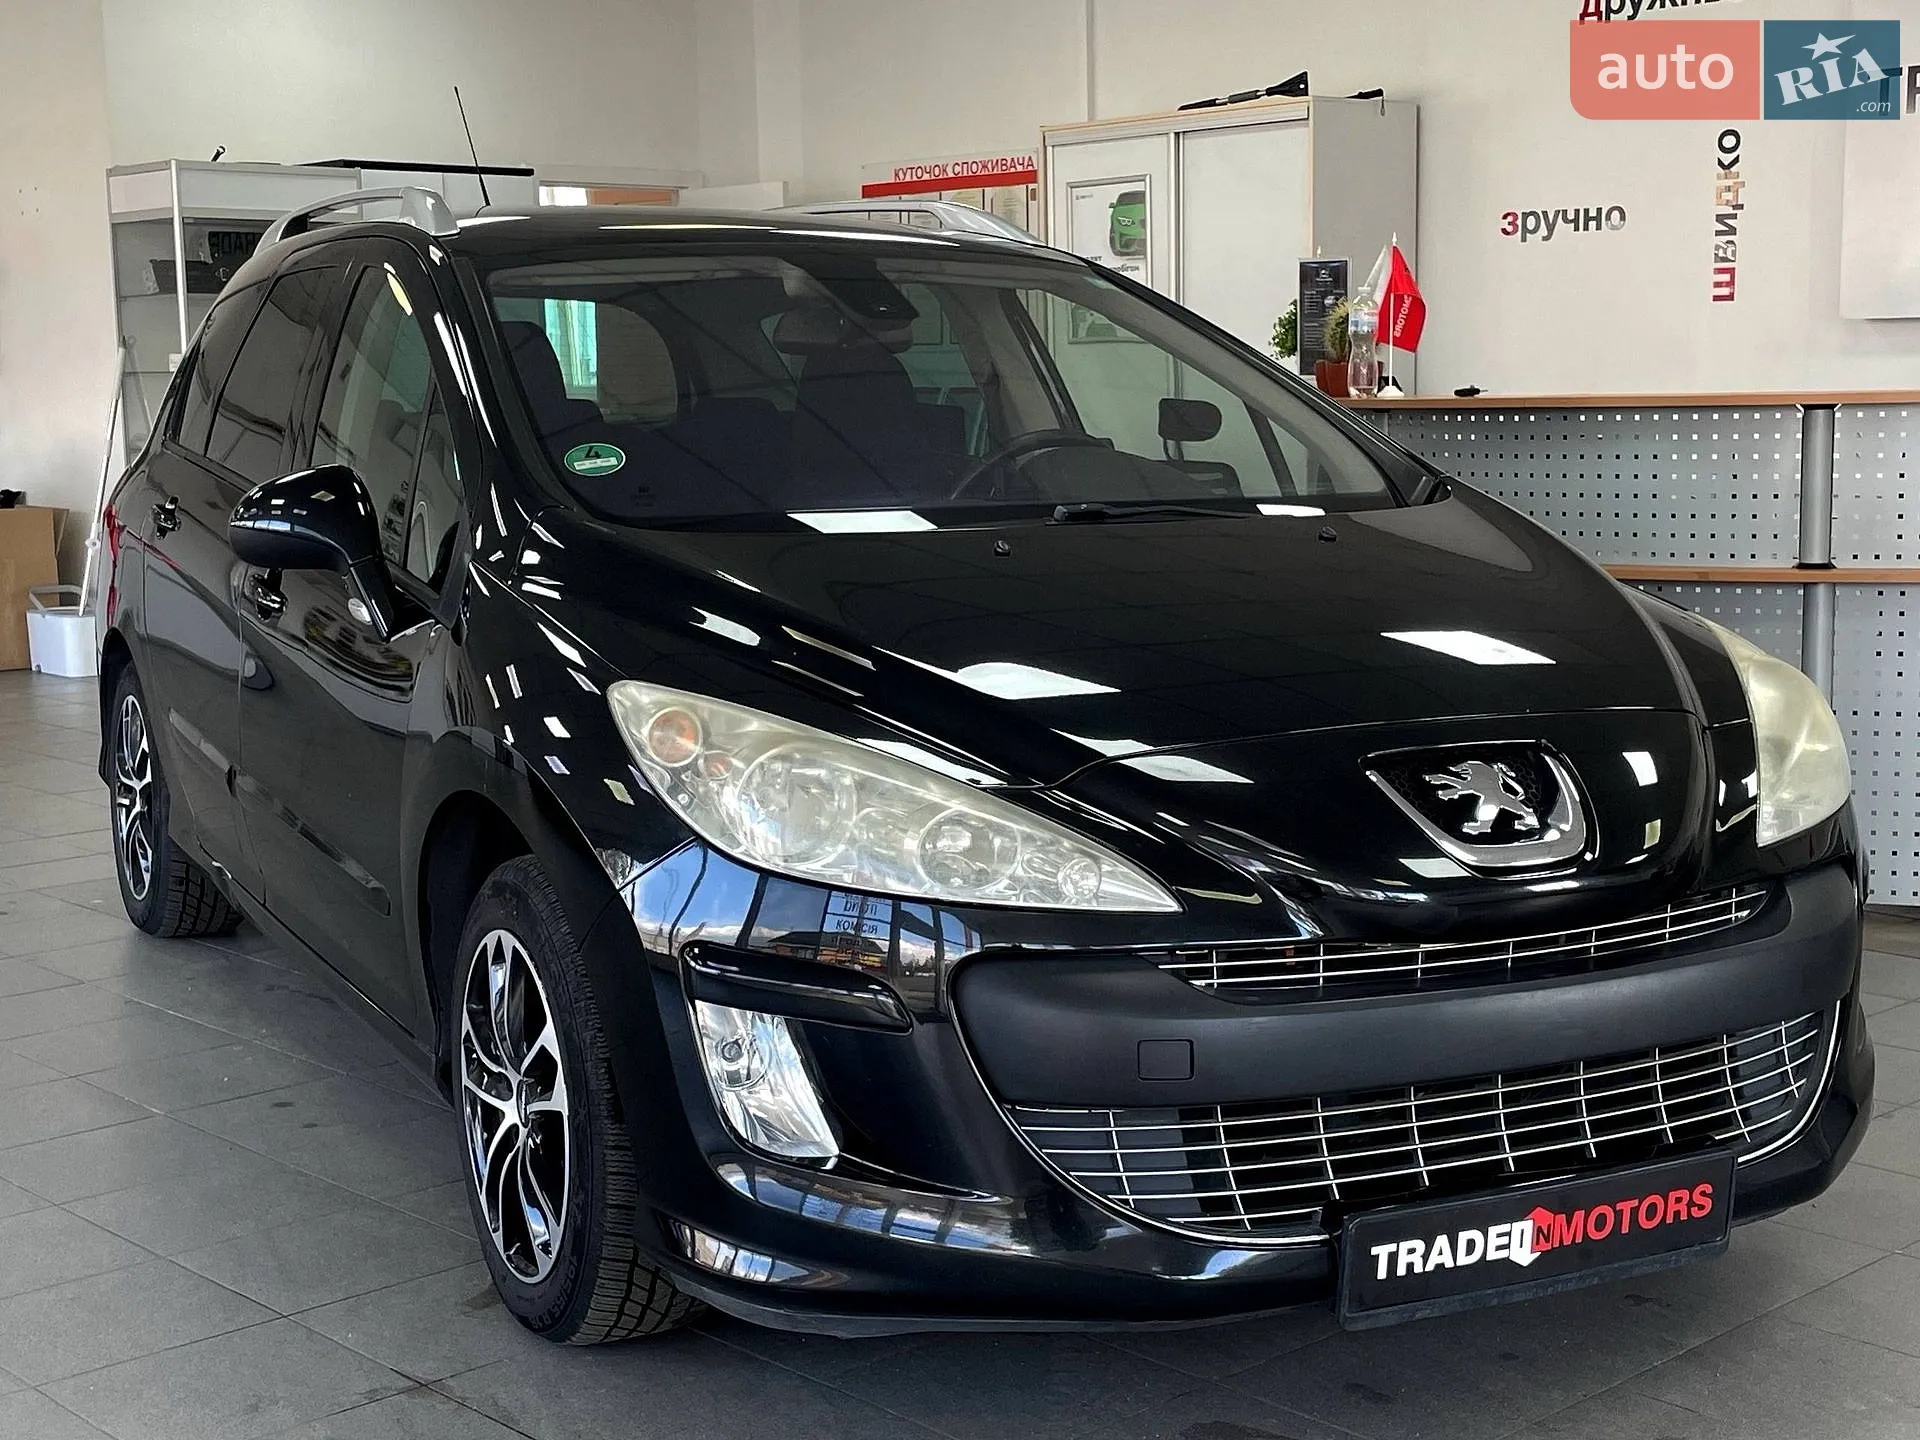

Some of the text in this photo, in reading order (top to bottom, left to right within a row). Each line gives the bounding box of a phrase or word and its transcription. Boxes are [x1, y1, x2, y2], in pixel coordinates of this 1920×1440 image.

[893, 155, 1035, 181] КУТОЧОК СПОЖИВАЧА
[1500, 204, 1627, 243] зручно
[1712, 128, 1746, 303] швидко
